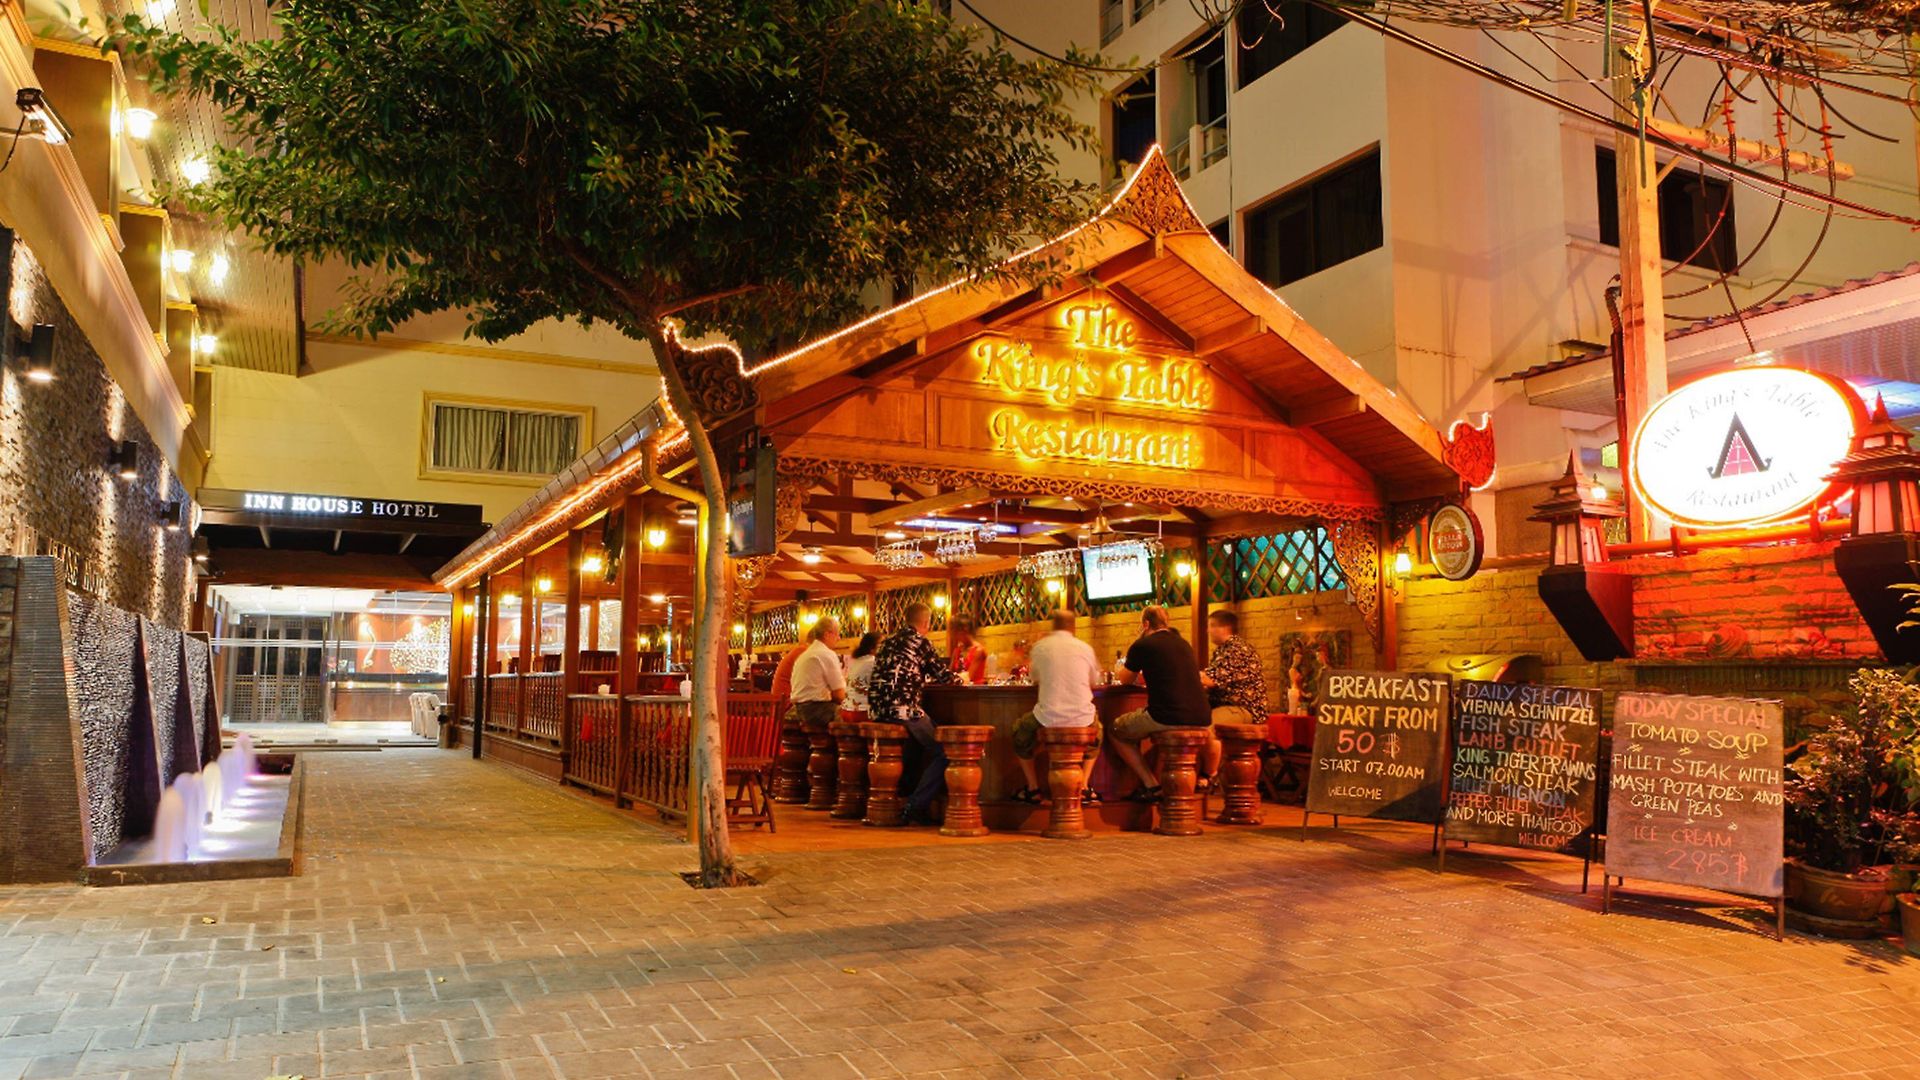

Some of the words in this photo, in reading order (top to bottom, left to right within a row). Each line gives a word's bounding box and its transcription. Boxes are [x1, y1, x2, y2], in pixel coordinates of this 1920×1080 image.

[1065, 303, 1137, 350] The
[976, 340, 1101, 404] King's
[1115, 357, 1212, 408] Table
[992, 409, 1200, 470] Restaurant
[244, 493, 283, 509] INN
[291, 495, 363, 514] HOUSE
[372, 501, 439, 518] HOTEL
[1328, 676, 1448, 704] BREAKFAST
[1466, 682, 1518, 701] DAILY
[1519, 685, 1594, 709] SPECIAL
[1318, 704, 1379, 728] START
[1384, 706, 1438, 733] FROM
[1460, 699, 1516, 717] VIENNA
[1519, 702, 1597, 726] SCHNITZEL
[1619, 696, 1682, 719] TODAY
[1685, 702, 1772, 729] SPECIAL
[1337, 729, 1376, 754] 50
[1460, 715, 1500, 734] FISH
[1507, 719, 1567, 742] STEAK
[1625, 722, 1700, 744] TOMATO
[1706, 730, 1768, 753] SOUP
[1459, 731, 1506, 750] LAMB
[1513, 736, 1581, 761] CUTLET
[1320, 758, 1361, 773] START
[1456, 747, 1490, 765] KING
[1496, 751, 1539, 771] TIGER
[1541, 756, 1596, 781] PRAWNS
[1613, 753, 1666, 771] FILLET
[1670, 758, 1732, 782] STEAK
[1738, 767, 1780, 785] WITH
[1328, 786, 1382, 800] WELCOME
[1452, 777, 1493, 794] FILLET
[1501, 783, 1566, 808] MIGNON
[1453, 763, 1519, 785] SALMON
[1523, 770, 1580, 796] STEAK
[1611, 773, 1656, 793] MASH
[1660, 776, 1744, 801] POTATOES
[1752, 790, 1784, 806] AND
[1446, 806, 1474, 822] AND
[1477, 809, 1514, 827] MORE
[1450, 791, 1492, 808] PEPPER
[1536, 802, 1585, 825] STEAK
[1630, 794, 1679, 814] GREEN
[1685, 798, 1724, 818] PEAS
[1634, 826, 1658, 841] ICE
[1671, 828, 1732, 849] CREAM
